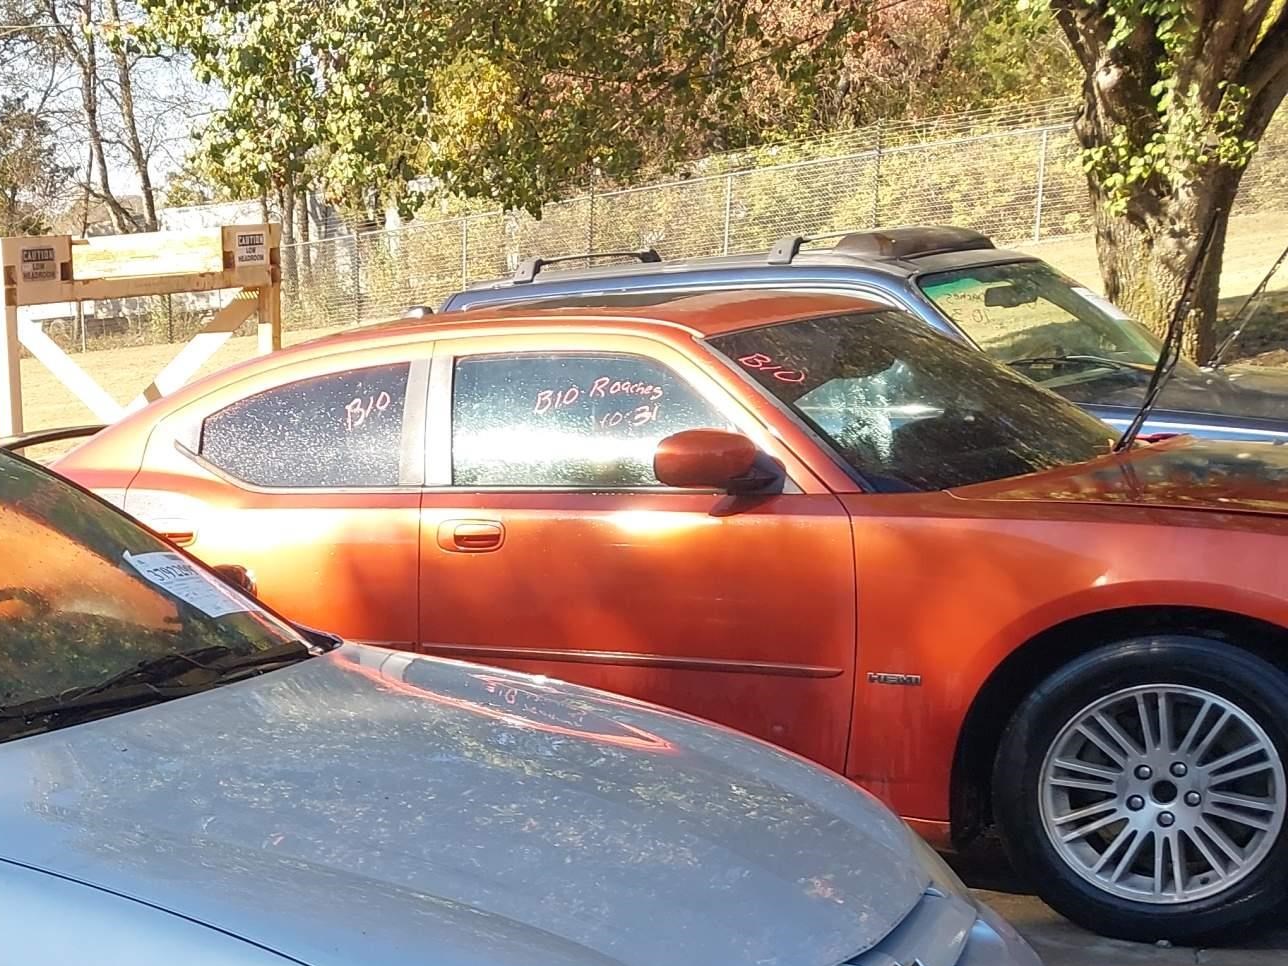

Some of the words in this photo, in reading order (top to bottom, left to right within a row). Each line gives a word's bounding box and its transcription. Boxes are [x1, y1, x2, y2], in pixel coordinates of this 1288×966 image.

[237, 236, 263, 245] CAUTION
[23, 249, 54, 260] CAUTION
[589, 377, 662, 400] Roaches
